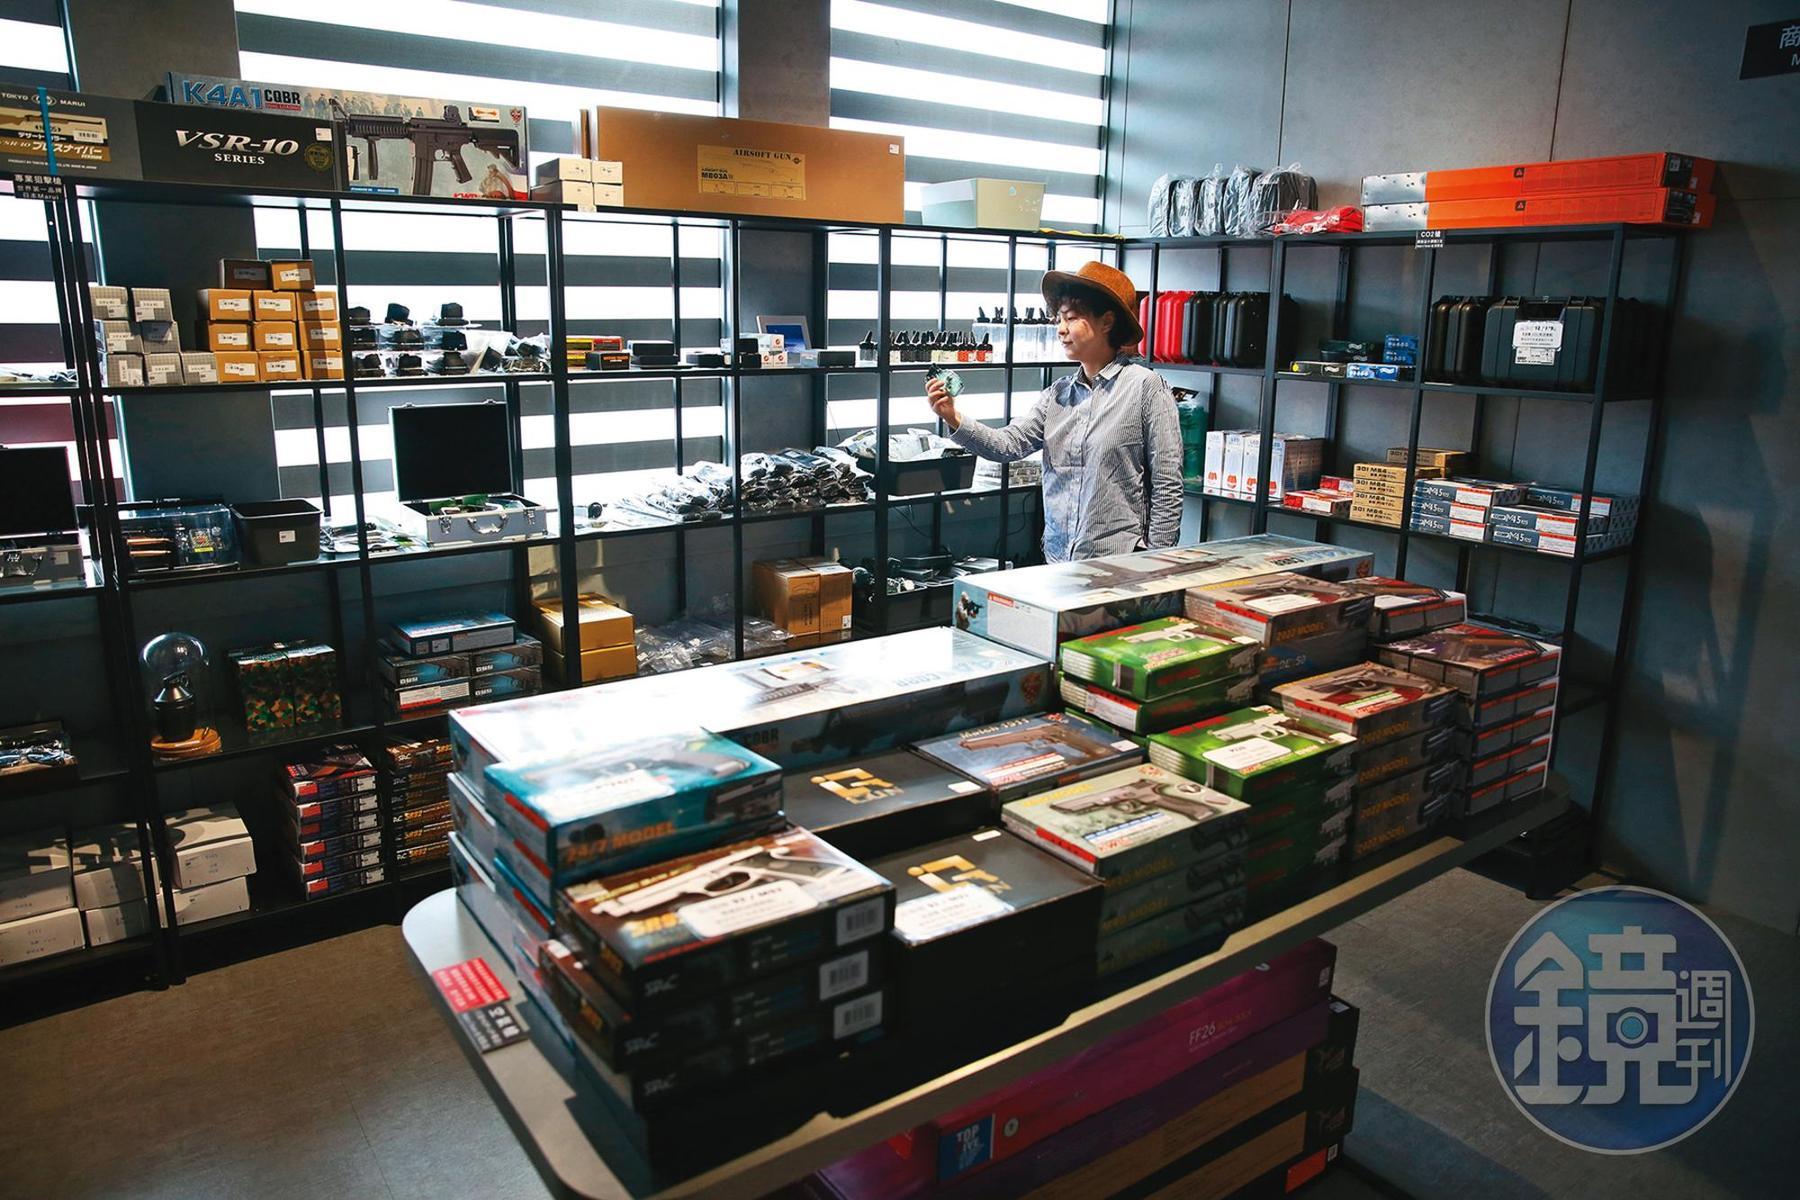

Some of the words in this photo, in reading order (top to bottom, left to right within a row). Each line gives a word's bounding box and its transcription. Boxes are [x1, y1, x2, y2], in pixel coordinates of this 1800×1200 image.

[2, 92, 29, 101] TOKYO
[60, 99, 86, 108] MARUI
[183, 79, 263, 110] K4A1
[175, 129, 299, 156] VSR-10
[214, 153, 265, 165] SERIES
[733, 149, 771, 159] AIRSOFT
[773, 153, 791, 161] GUN
[959, 725, 1000, 738] Match
[1002, 718, 1030, 729] 1911
[611, 821, 677, 848] MODEL
[1189, 1021, 1216, 1046] FF26
